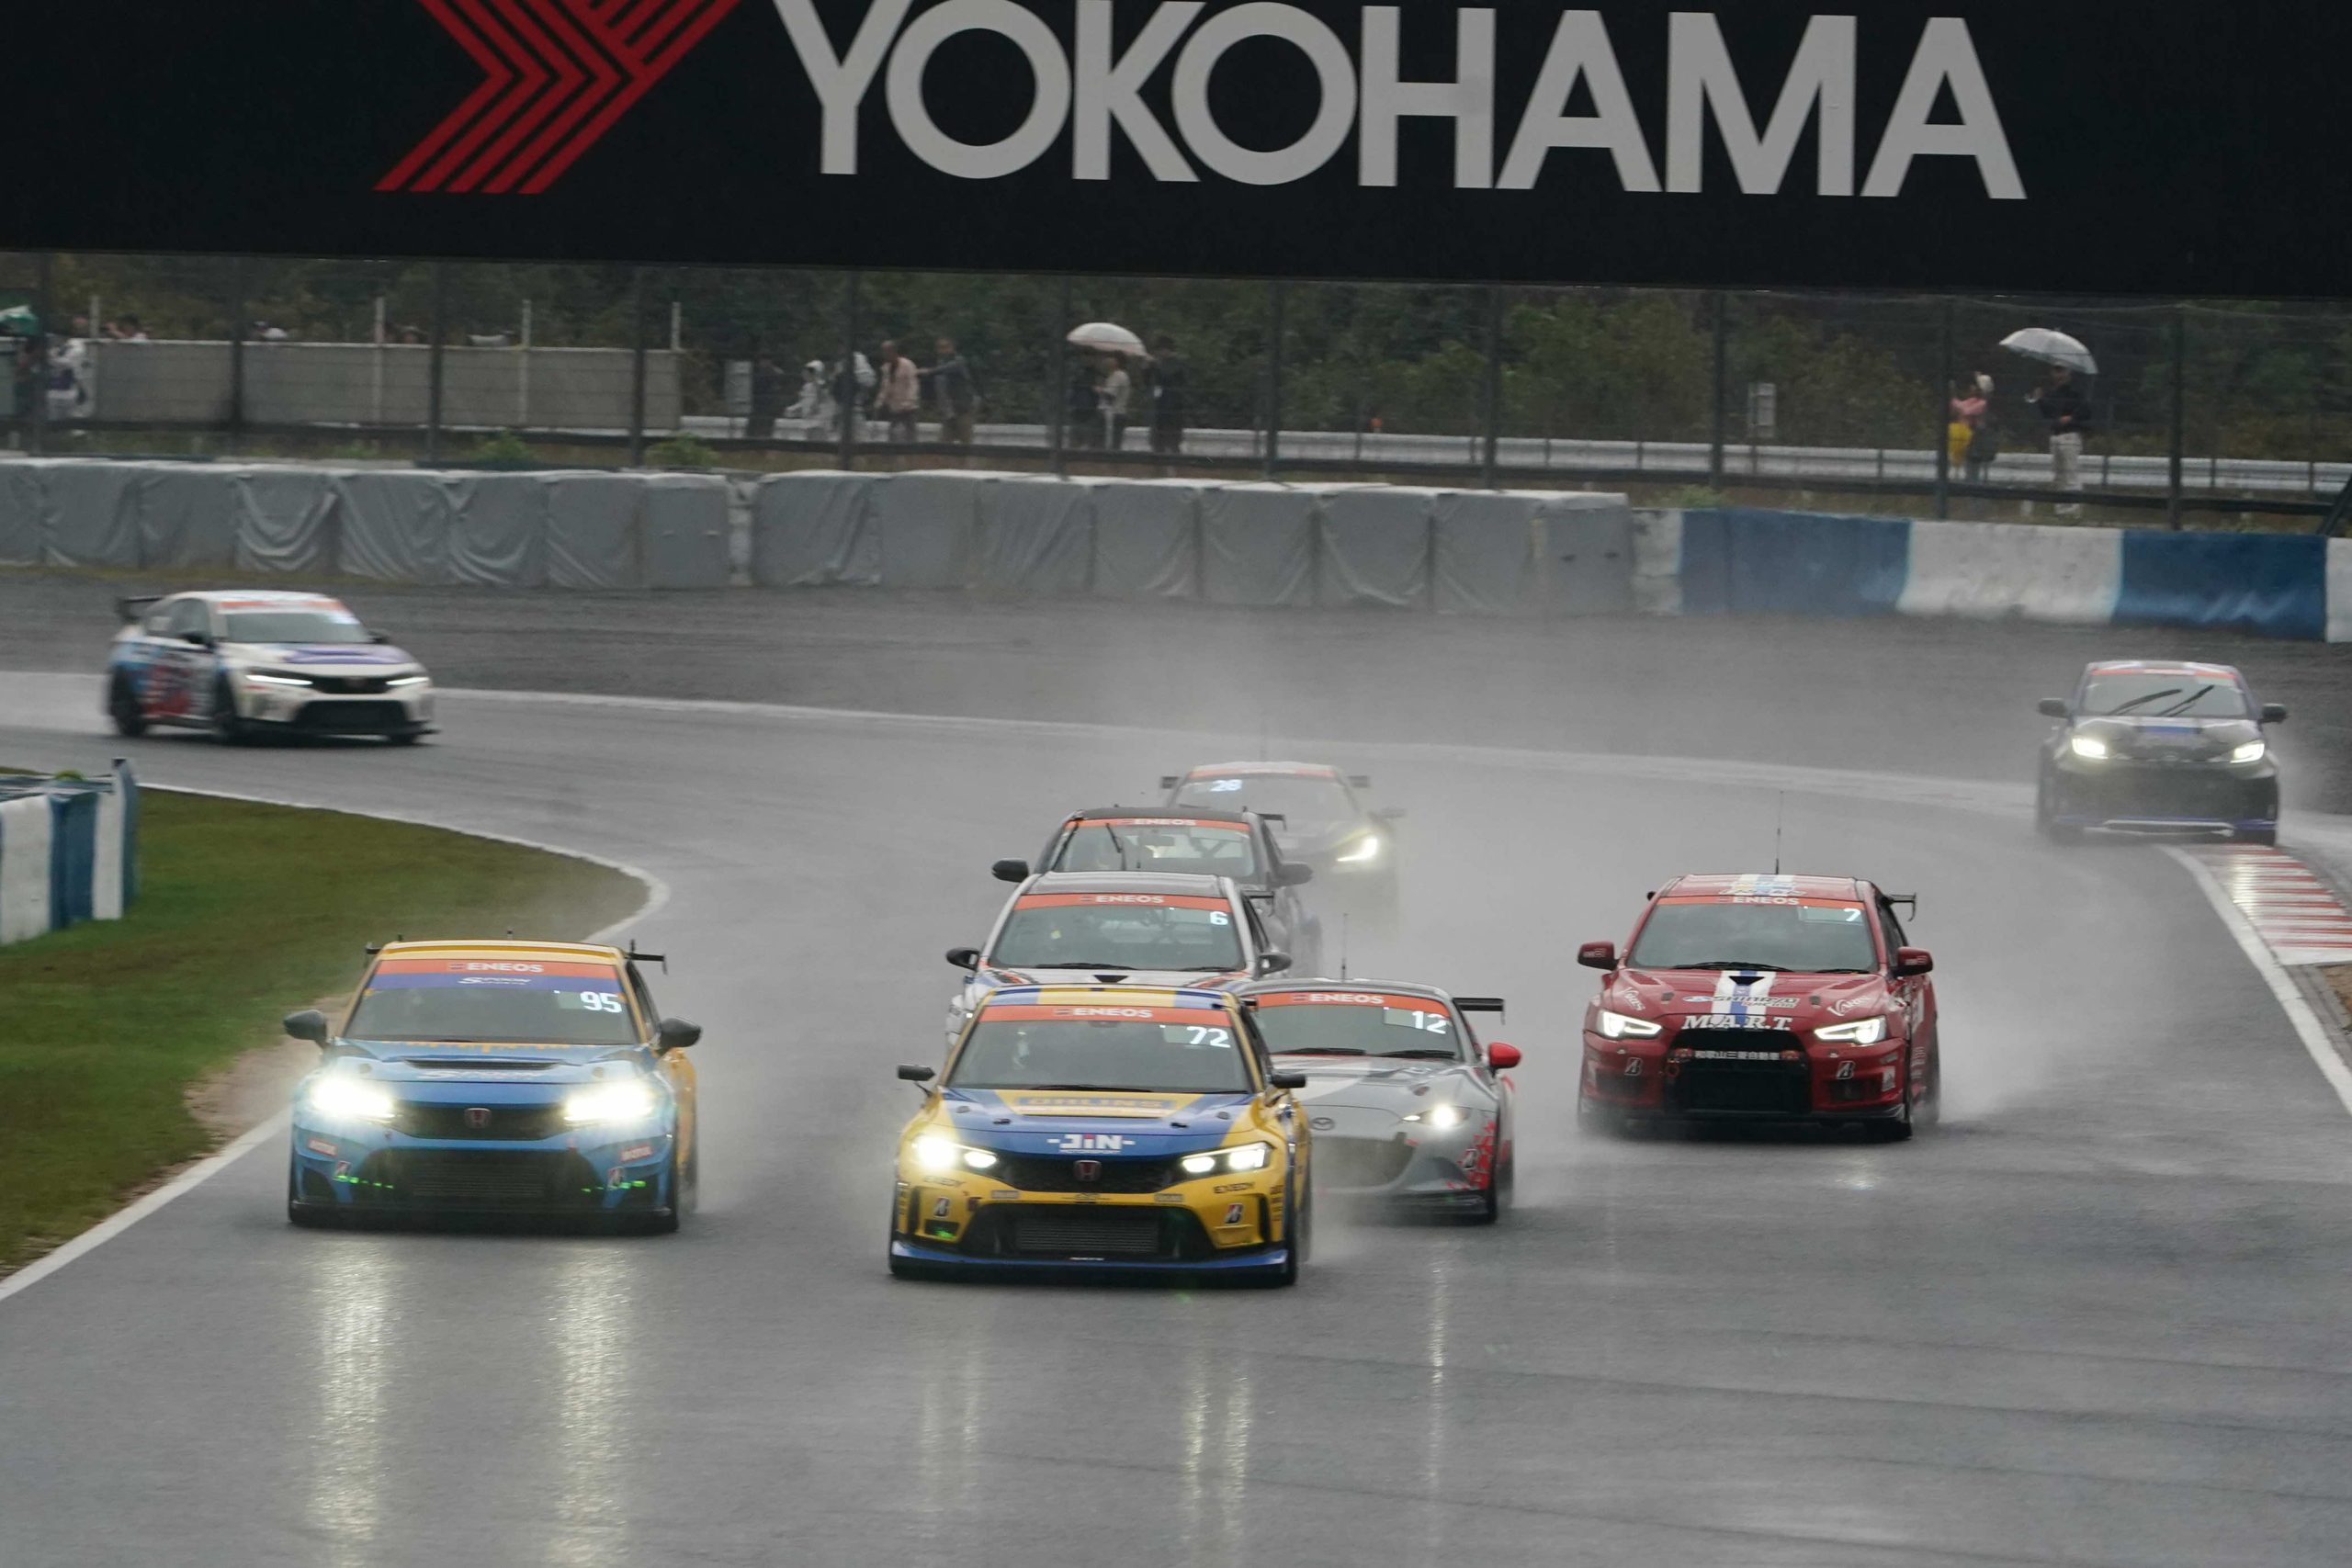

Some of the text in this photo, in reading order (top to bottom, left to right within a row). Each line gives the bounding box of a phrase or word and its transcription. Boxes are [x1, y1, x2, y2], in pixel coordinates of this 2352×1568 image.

[774, 0, 2028, 199] YOKOHAMA
[1095, 895, 1165, 904] ENEOS
[1733, 897, 1799, 906] ENEOS
[1209, 911, 1228, 926] 6
[1844, 908, 1861, 922] 7
[467, 963, 544, 974] ENEOS
[580, 991, 622, 1013] 95
[1309, 994, 1385, 1004] ENEOS
[1073, 1008, 1153, 1019] ENEOS
[1411, 1010, 1447, 1034] 12
[1186, 1026, 1231, 1049] 72
